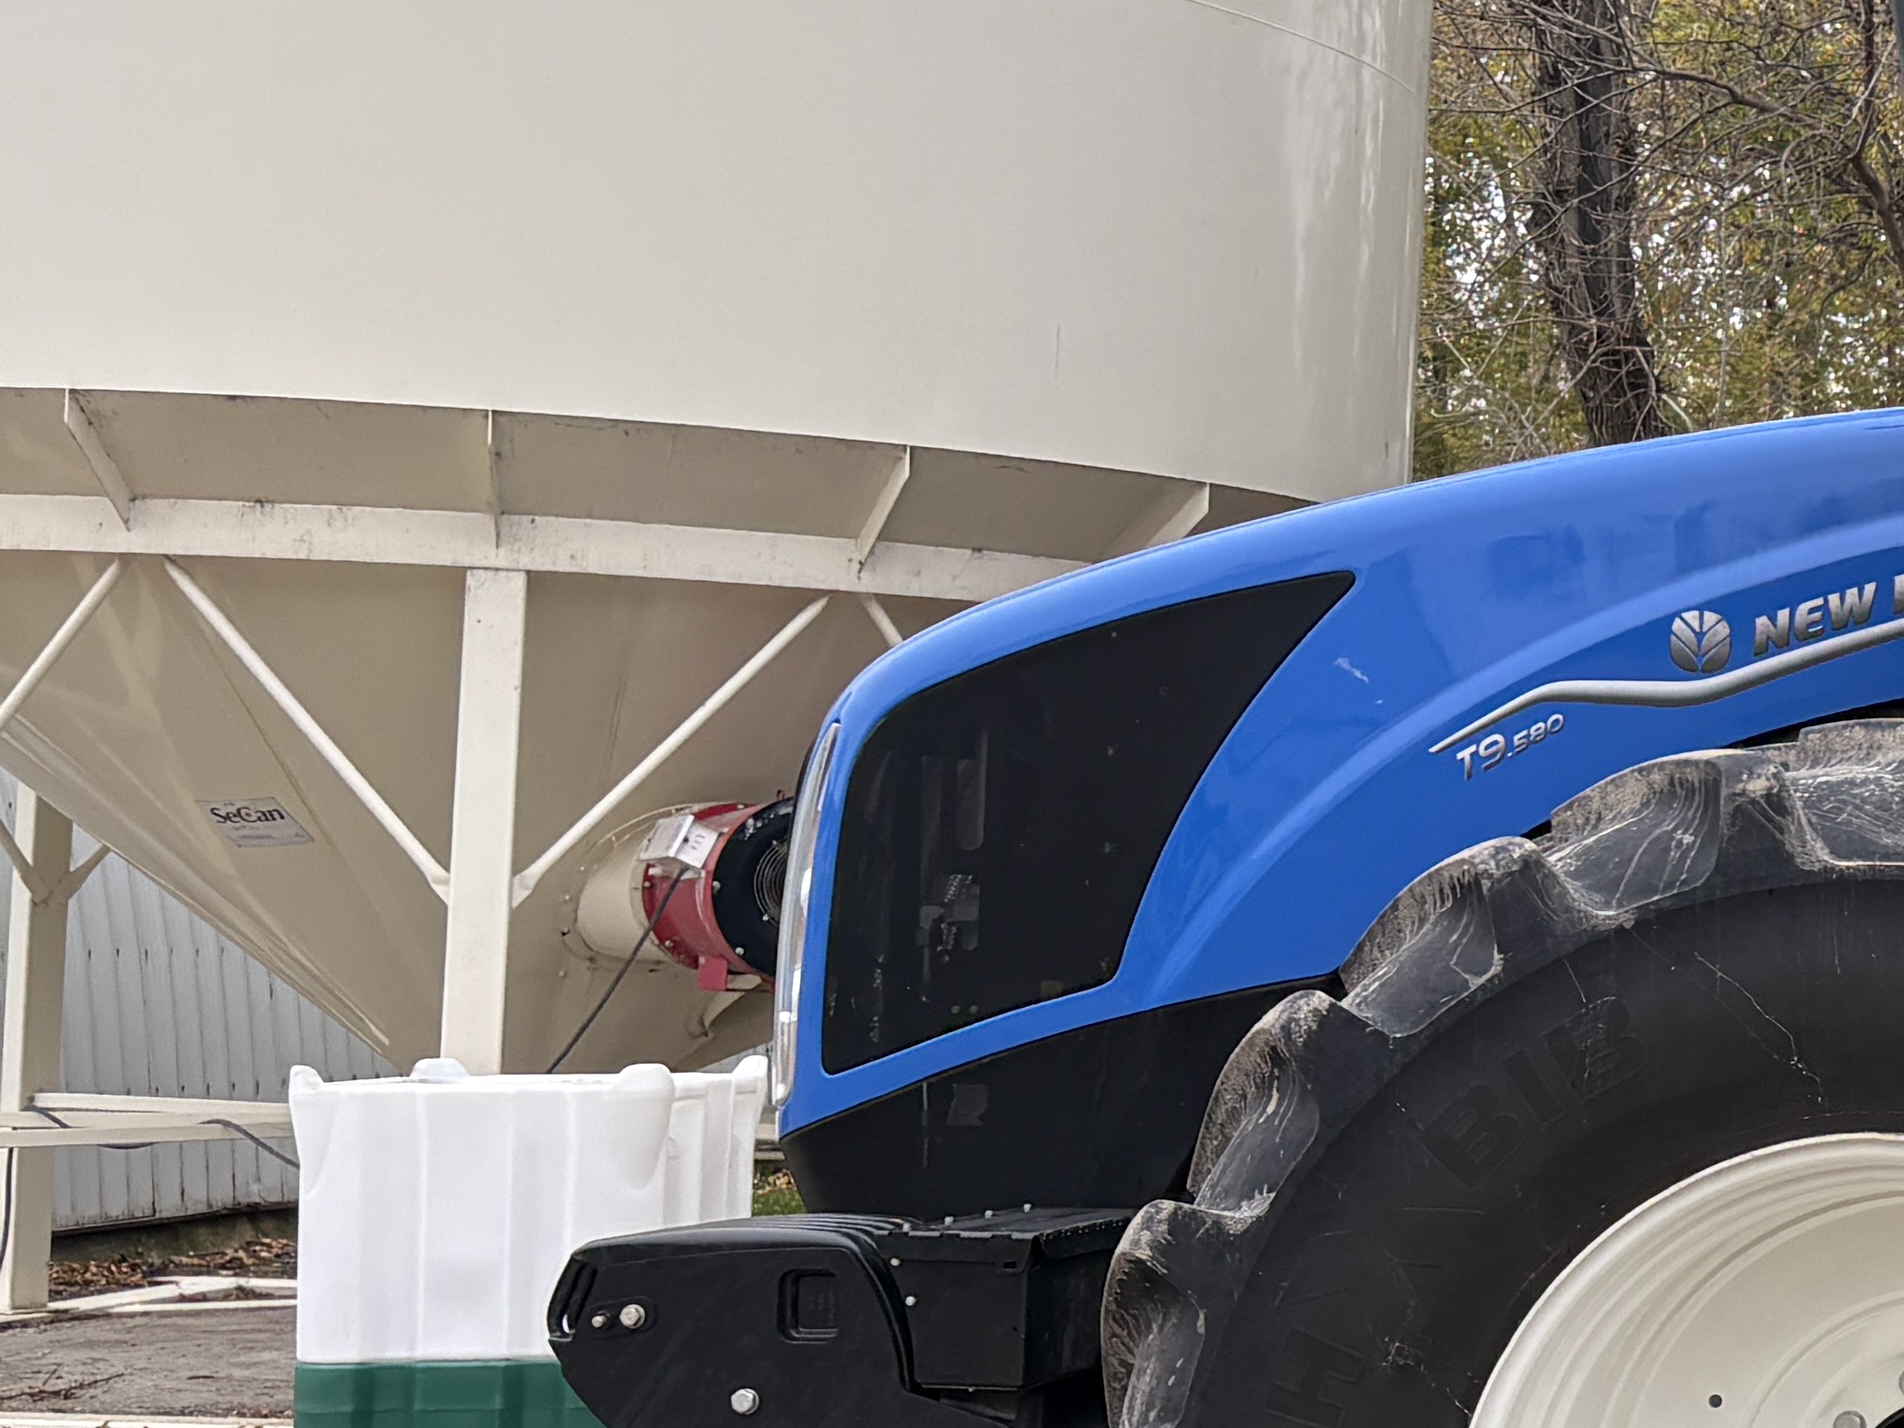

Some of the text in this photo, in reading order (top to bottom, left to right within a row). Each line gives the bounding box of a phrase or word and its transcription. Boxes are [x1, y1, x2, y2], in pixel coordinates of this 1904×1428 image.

[1754, 582, 1877, 656] NEW
[1456, 713, 1564, 781] T9.580
[209, 806, 285, 824] SeCan
[1412, 990, 1654, 1197] BIB
